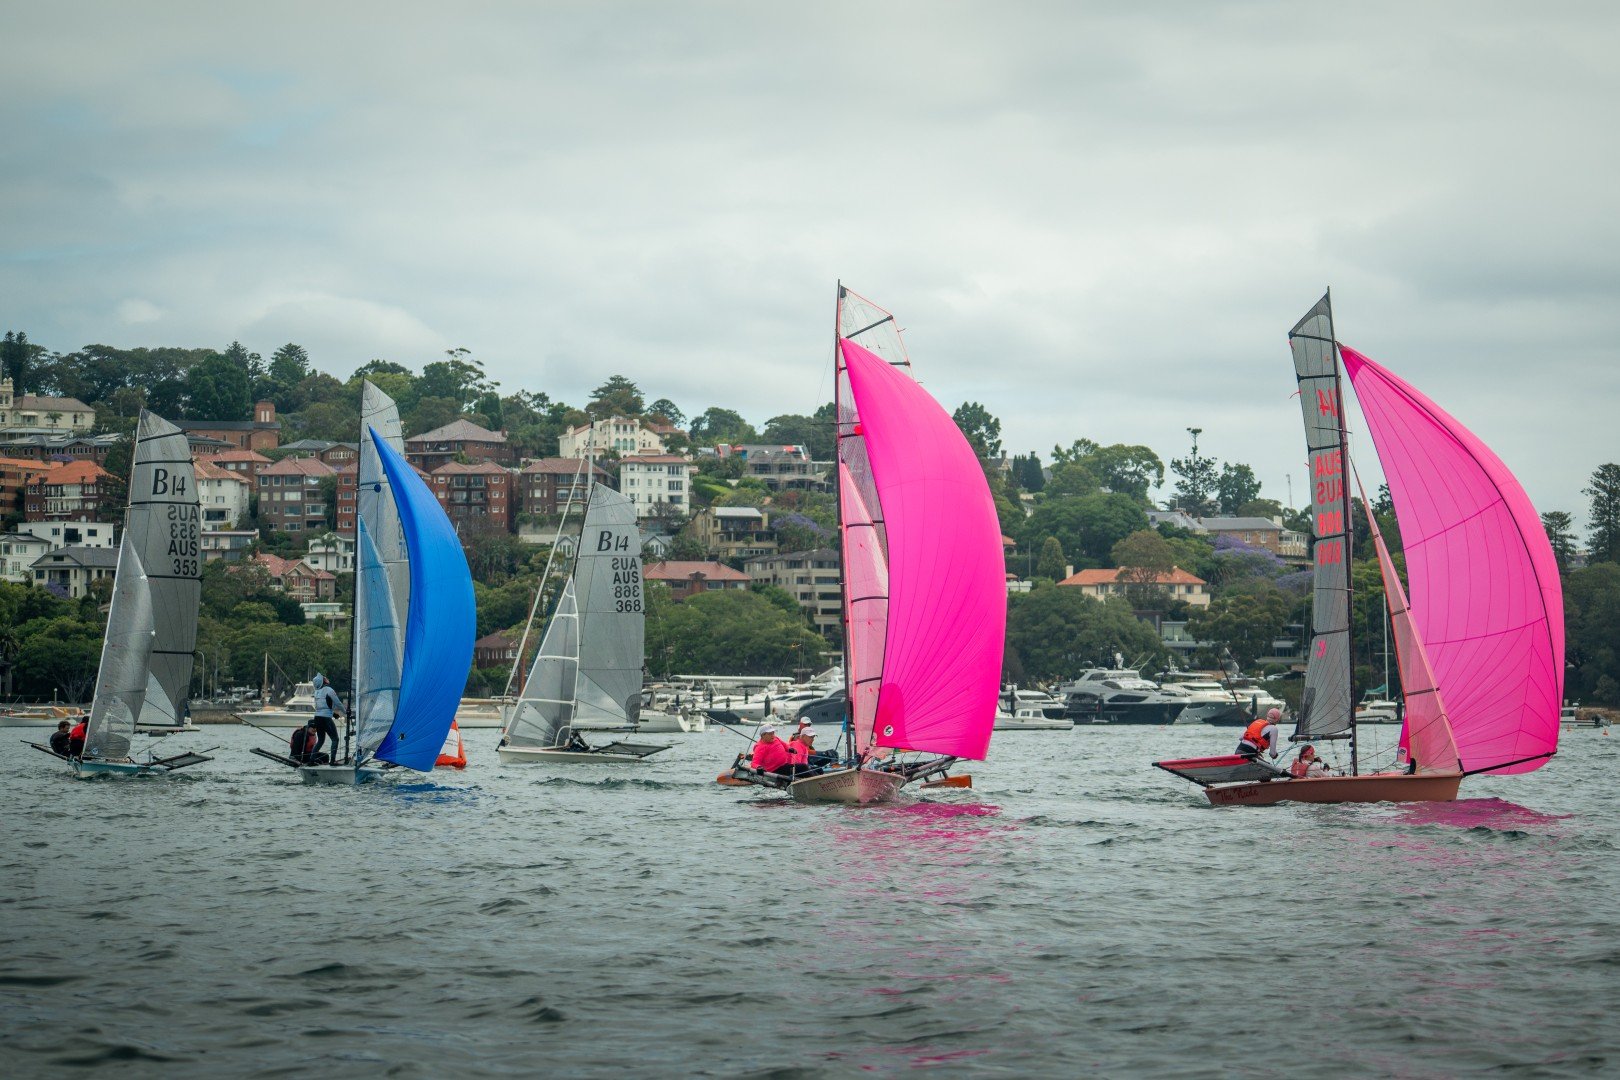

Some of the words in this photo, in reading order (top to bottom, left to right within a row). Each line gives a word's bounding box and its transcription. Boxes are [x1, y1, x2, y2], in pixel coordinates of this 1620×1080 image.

[168, 540, 198, 557] AUS
[173, 558, 198, 576] 353
[613, 571, 639, 585] AUS
[616, 599, 642, 613] 368
